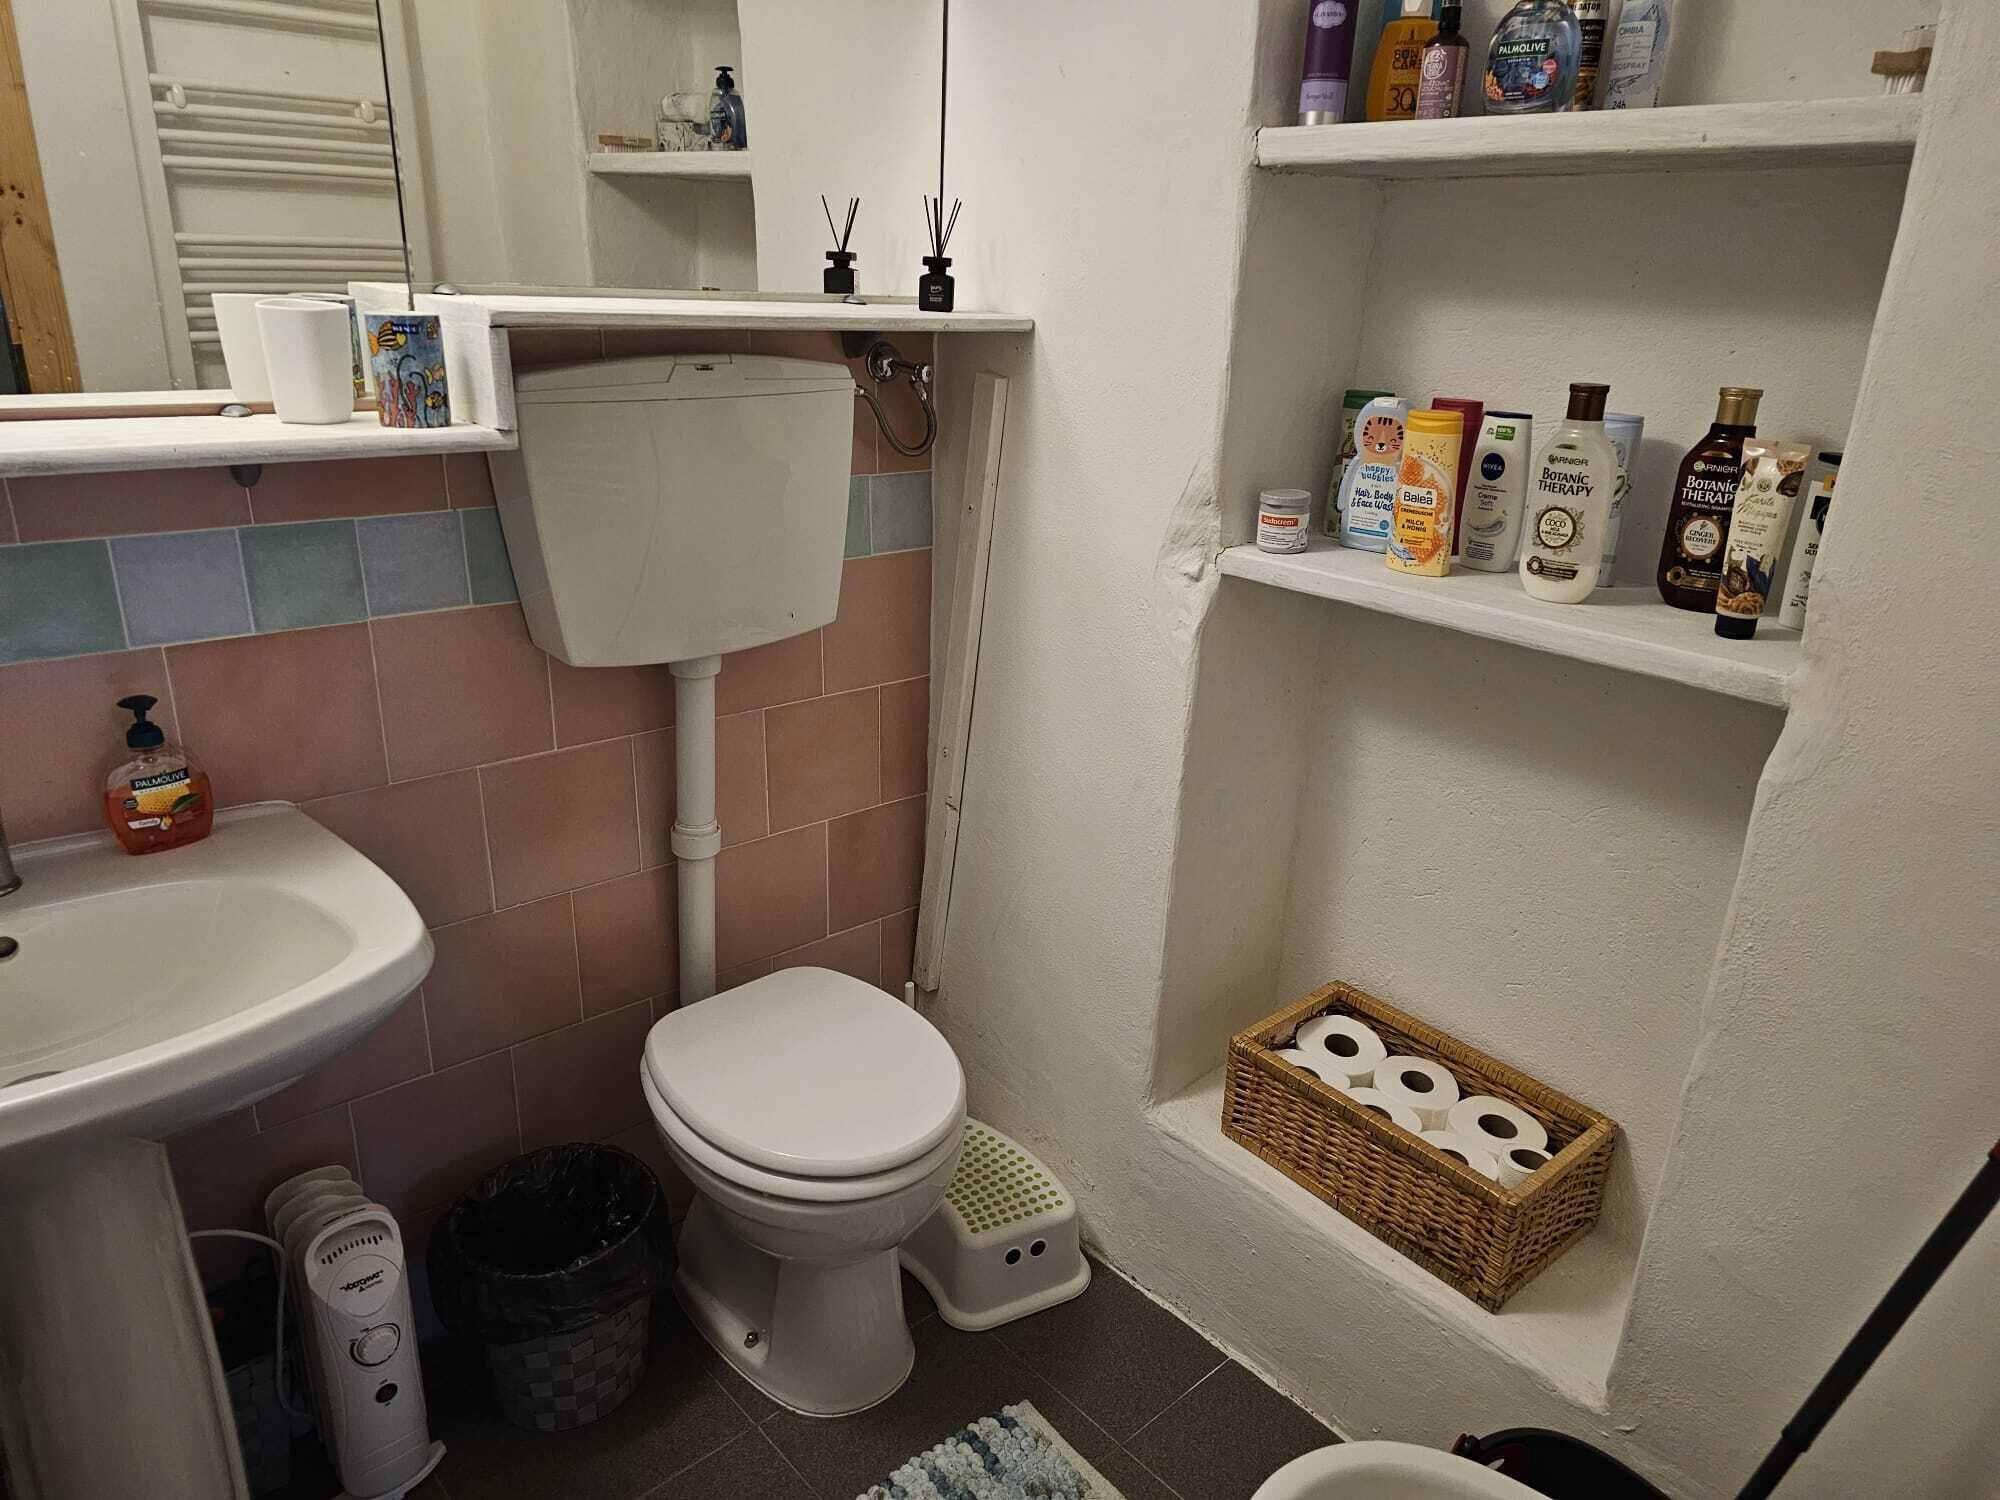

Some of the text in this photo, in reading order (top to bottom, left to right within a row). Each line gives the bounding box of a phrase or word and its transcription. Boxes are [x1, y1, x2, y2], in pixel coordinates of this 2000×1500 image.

[1498, 42, 1547, 55] PALMOLIVE
[1386, 87, 1415, 112] 30
[1548, 455, 1589, 466] GARNIER
[1365, 464, 1391, 474] happy
[1693, 461, 1738, 474] GARNIER
[1361, 472, 1394, 482] bubbles
[1538, 480, 1594, 497] THERAPY
[1374, 490, 1394, 502] Body
[1403, 491, 1433, 505] Balea
[1681, 488, 1736, 504] THERAP
[1263, 517, 1294, 526] sudocrem
[1545, 518, 1567, 528] COCO
[1685, 535, 1716, 545] RECOVERY
[1689, 528, 1715, 540] GINGER
[135, 770, 186, 789] PALMOLIVE
